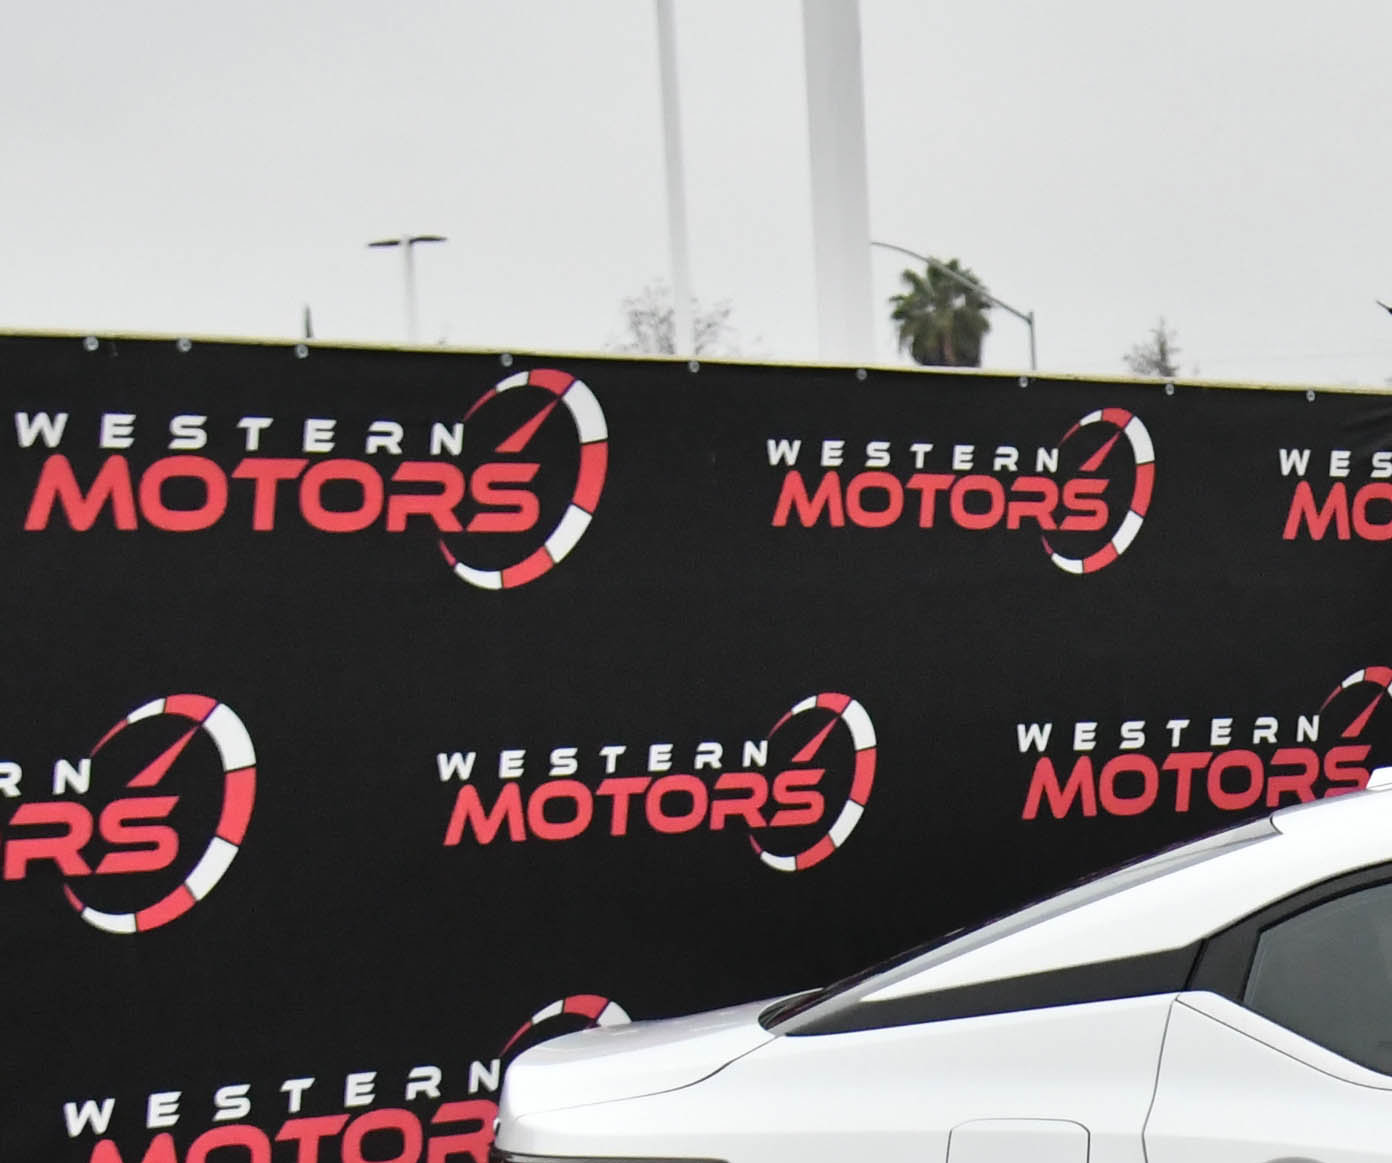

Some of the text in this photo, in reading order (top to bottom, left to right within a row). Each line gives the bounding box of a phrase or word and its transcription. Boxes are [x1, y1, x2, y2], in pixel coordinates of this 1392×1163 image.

[15, 412, 464, 456] WESTERN
[767, 439, 1059, 472] WESTERN
[23, 453, 541, 533] MOTORS
[771, 469, 1109, 532] MOTORS
[437, 739, 769, 782] WESTERN
[1017, 714, 1320, 754] WESTERN
[442, 768, 826, 847] MOTORS
[1020, 744, 1372, 820] MOTORS
[64, 1058, 501, 1138] WESTERN
